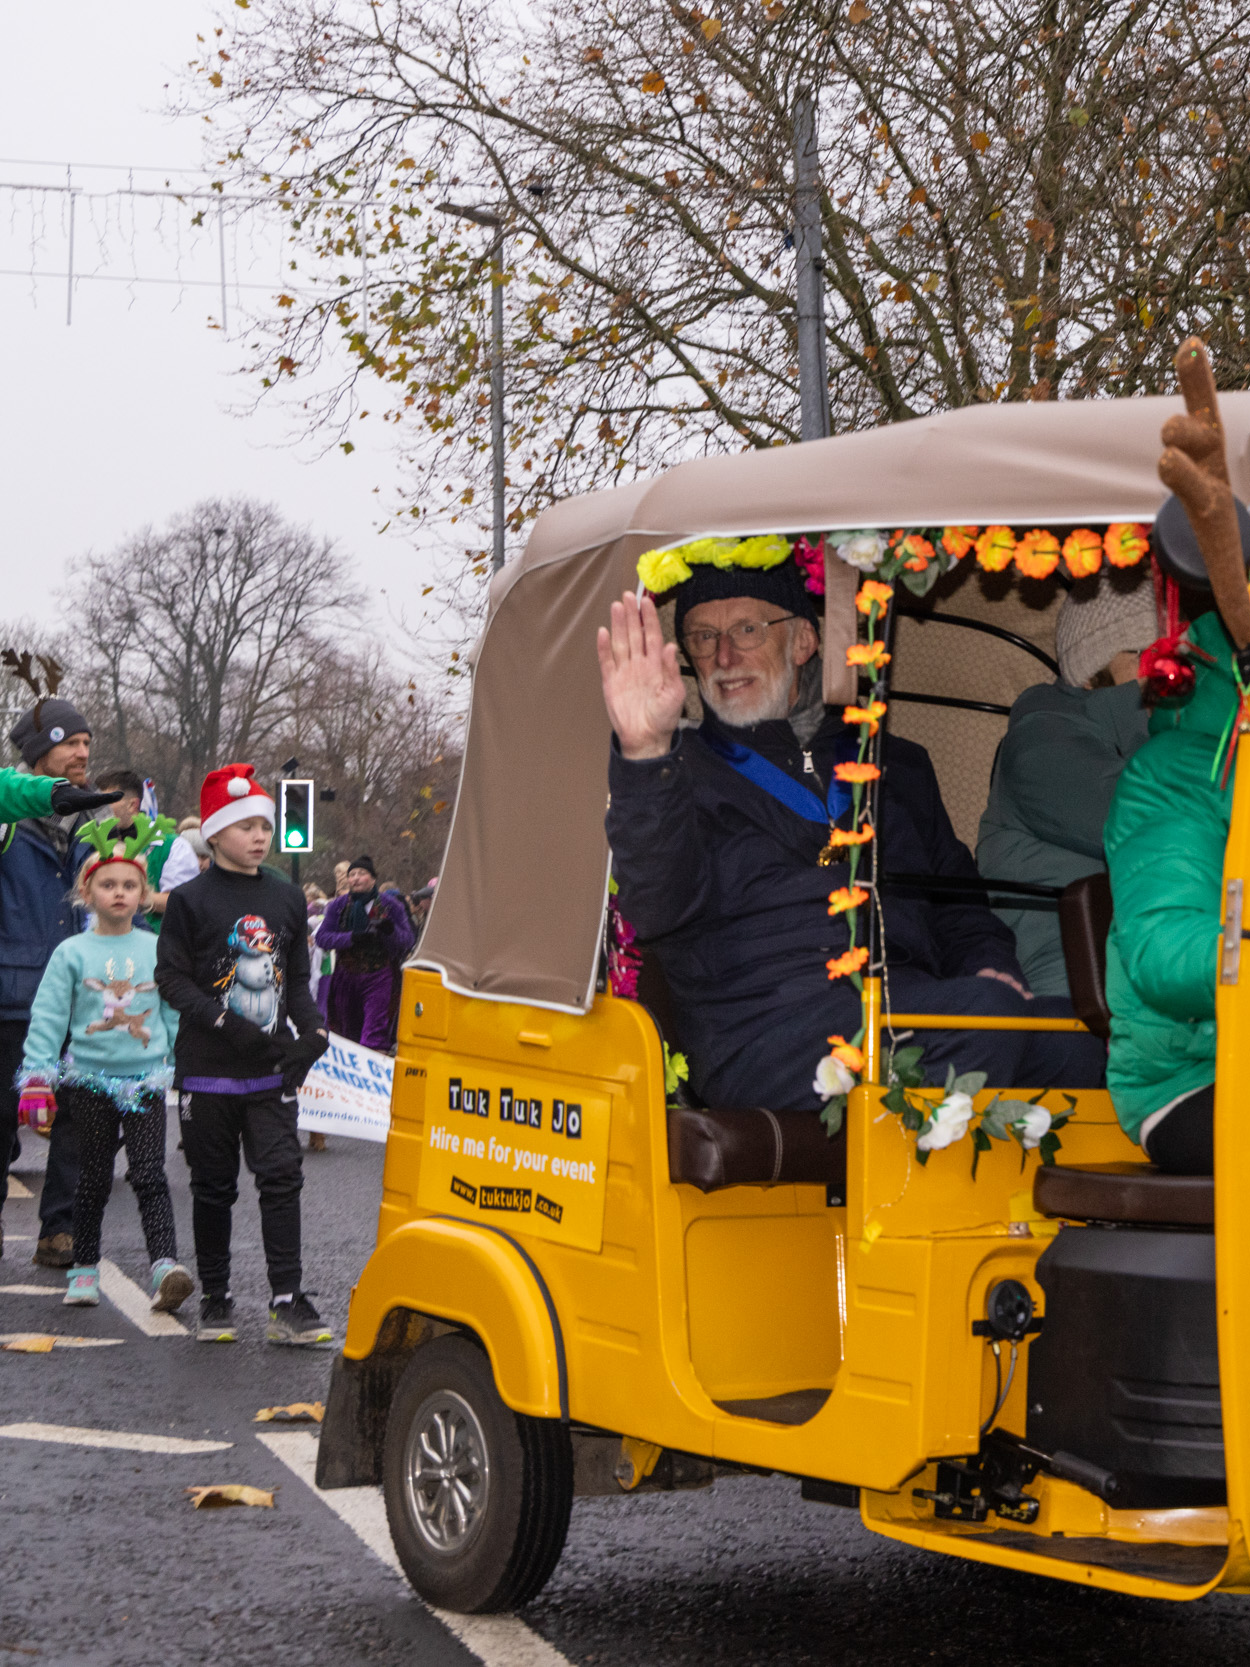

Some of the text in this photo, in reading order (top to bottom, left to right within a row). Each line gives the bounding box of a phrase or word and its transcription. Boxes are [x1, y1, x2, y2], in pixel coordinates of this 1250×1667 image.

[449, 1084, 581, 1135] Tuk Tuk Jo
[429, 1125, 596, 1184] Hire me for your event
[480, 1186, 532, 1212] tuktukjo
